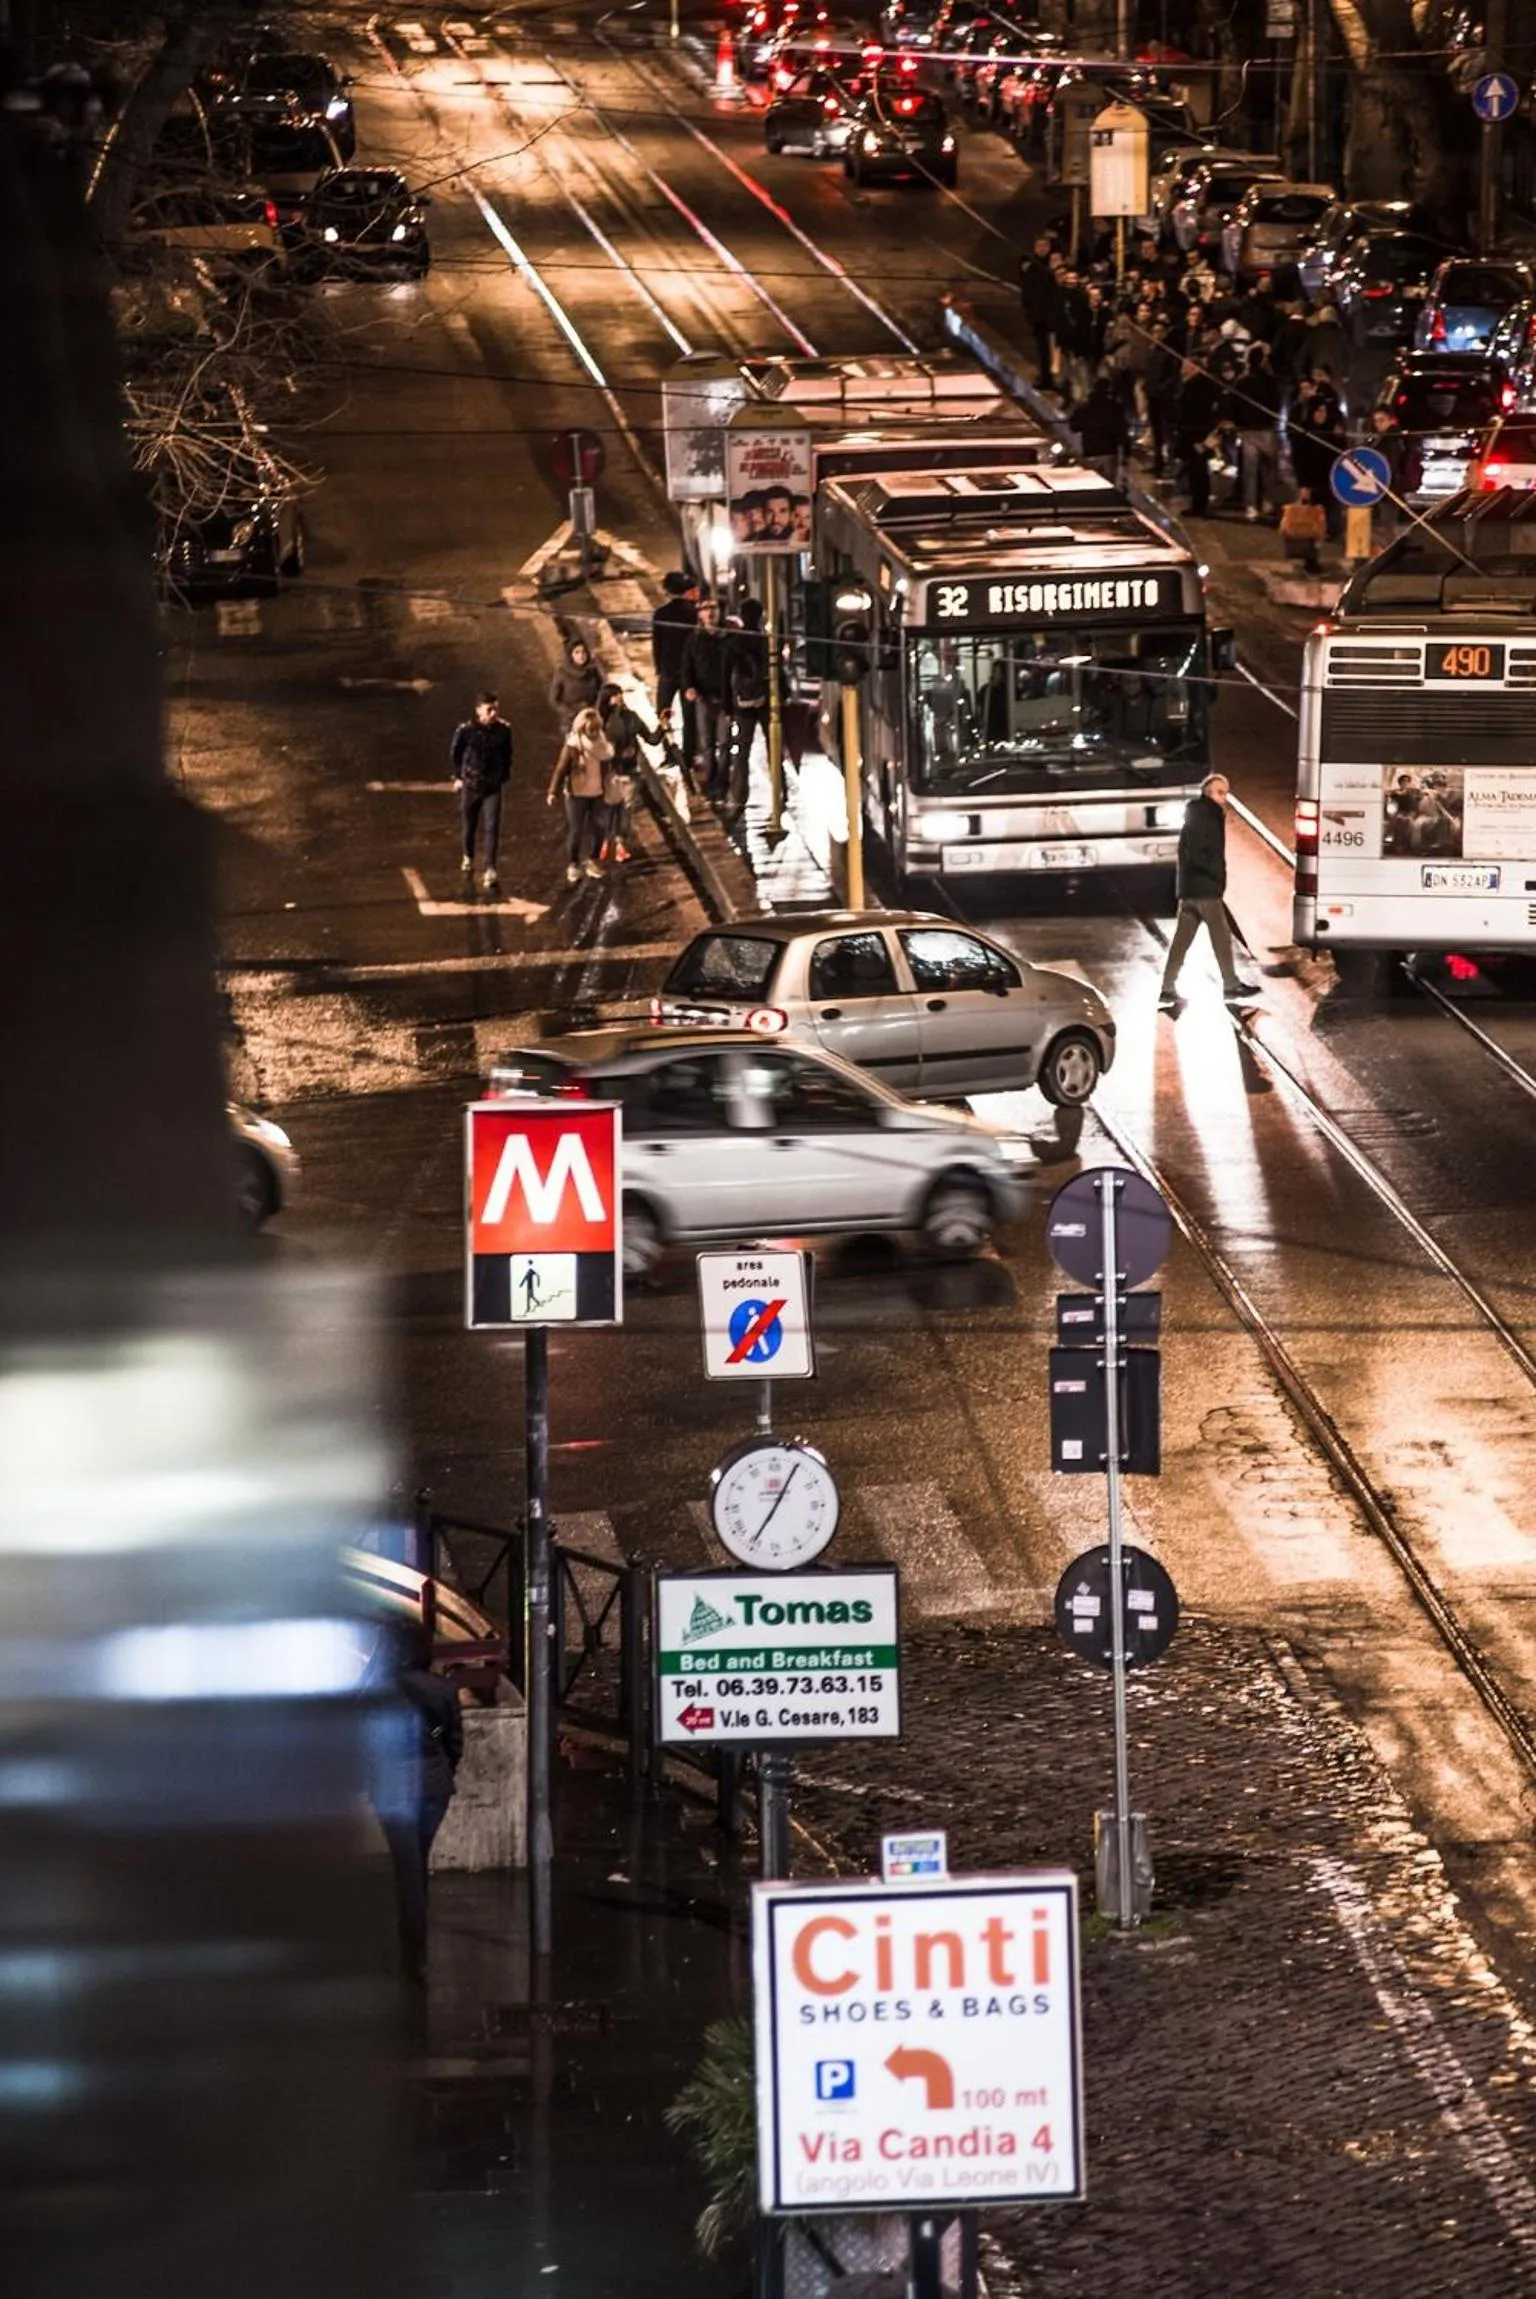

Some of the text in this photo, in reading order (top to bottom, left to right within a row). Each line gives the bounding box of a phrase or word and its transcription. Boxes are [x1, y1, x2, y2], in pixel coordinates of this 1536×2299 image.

[936, 579, 1159, 617] 32 RISORGIMENTO
[1442, 646, 1490, 676] 490
[1322, 831, 1364, 847] 4496
[481, 1133, 607, 1224] M
[737, 1262, 763, 1270] area
[723, 1276, 780, 1290] pedonale
[734, 1594, 873, 1626] Tomas
[680, 1649, 874, 1671] Bed and Breakfast
[672, 1674, 883, 1698] Tel. 06.39.73.63.15
[720, 1705, 879, 1728] V.le G. Cesare, 183
[792, 1909, 1050, 1996] Cinti
[800, 1994, 1050, 2024] SHOES & BAGS
[963, 2086, 1048, 2109] 100 mt
[800, 2122, 1054, 2163] Via Candia 4
[796, 2160, 1059, 2196] (angolo Via Leone IV)
